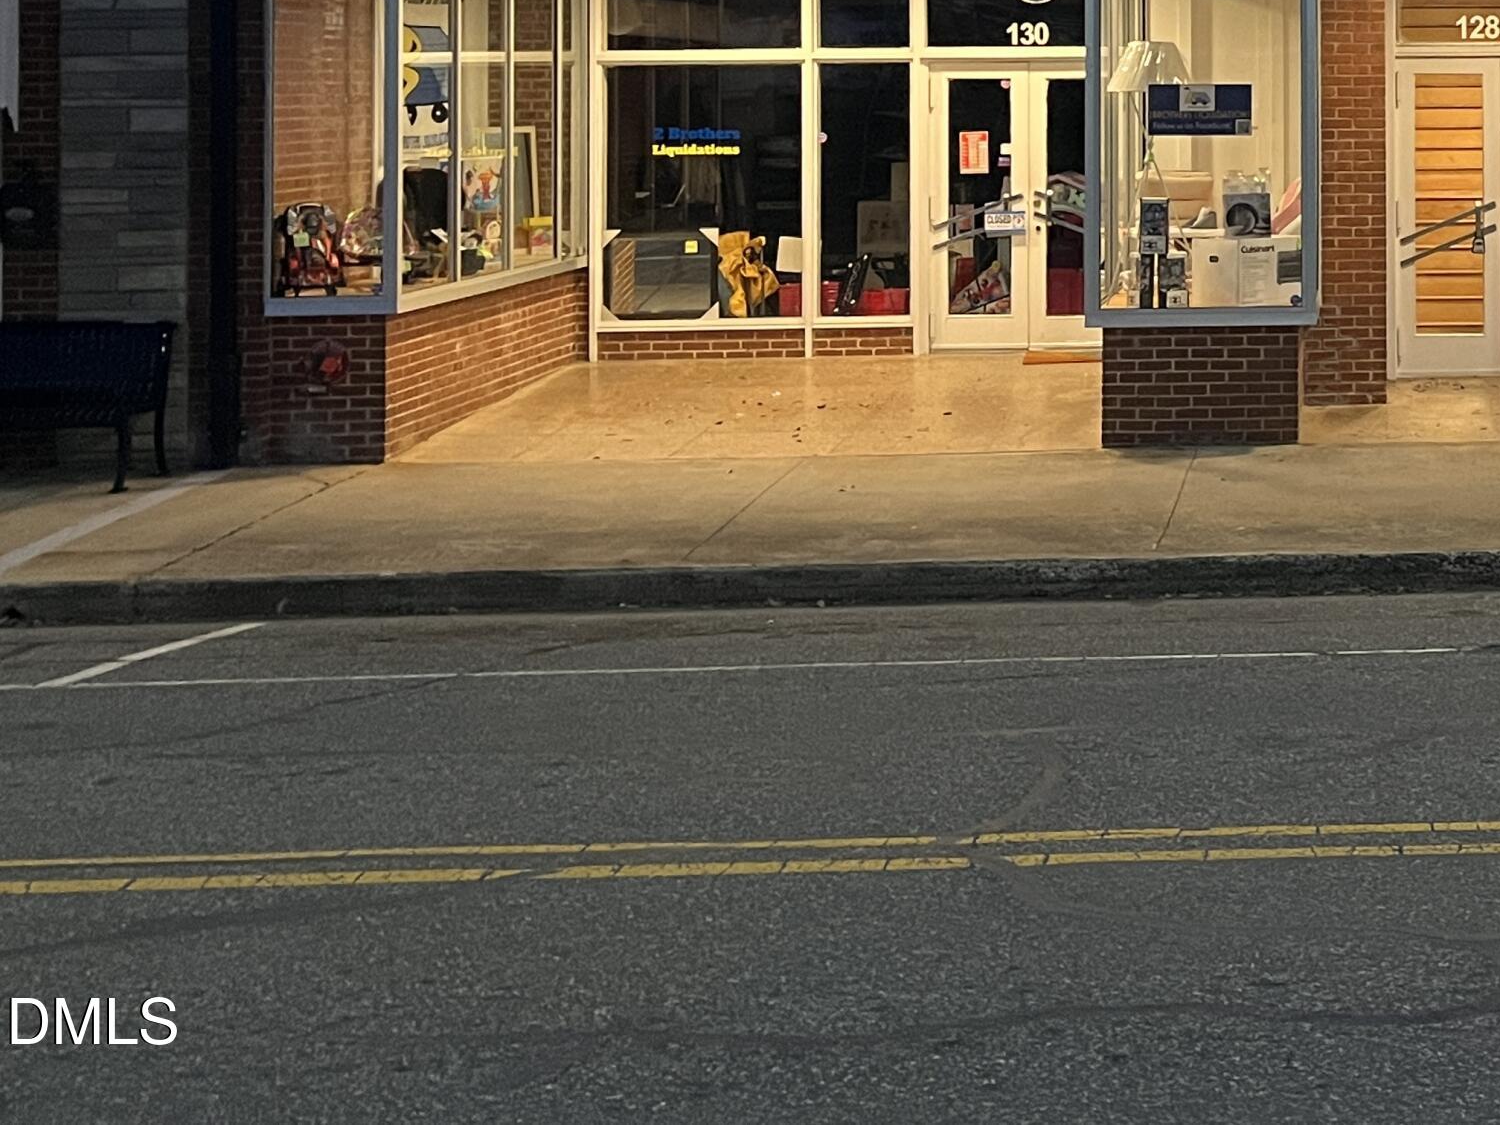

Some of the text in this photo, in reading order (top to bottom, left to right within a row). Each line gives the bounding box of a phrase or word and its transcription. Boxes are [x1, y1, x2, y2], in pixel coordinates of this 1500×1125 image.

[1006, 21, 1050, 45] 130
[653, 127, 741, 140] 2 Brothers
[652, 143, 741, 158] Liquidations
[986, 215, 1012, 224] CLOSED
[1240, 245, 1275, 254] Cuisinart
